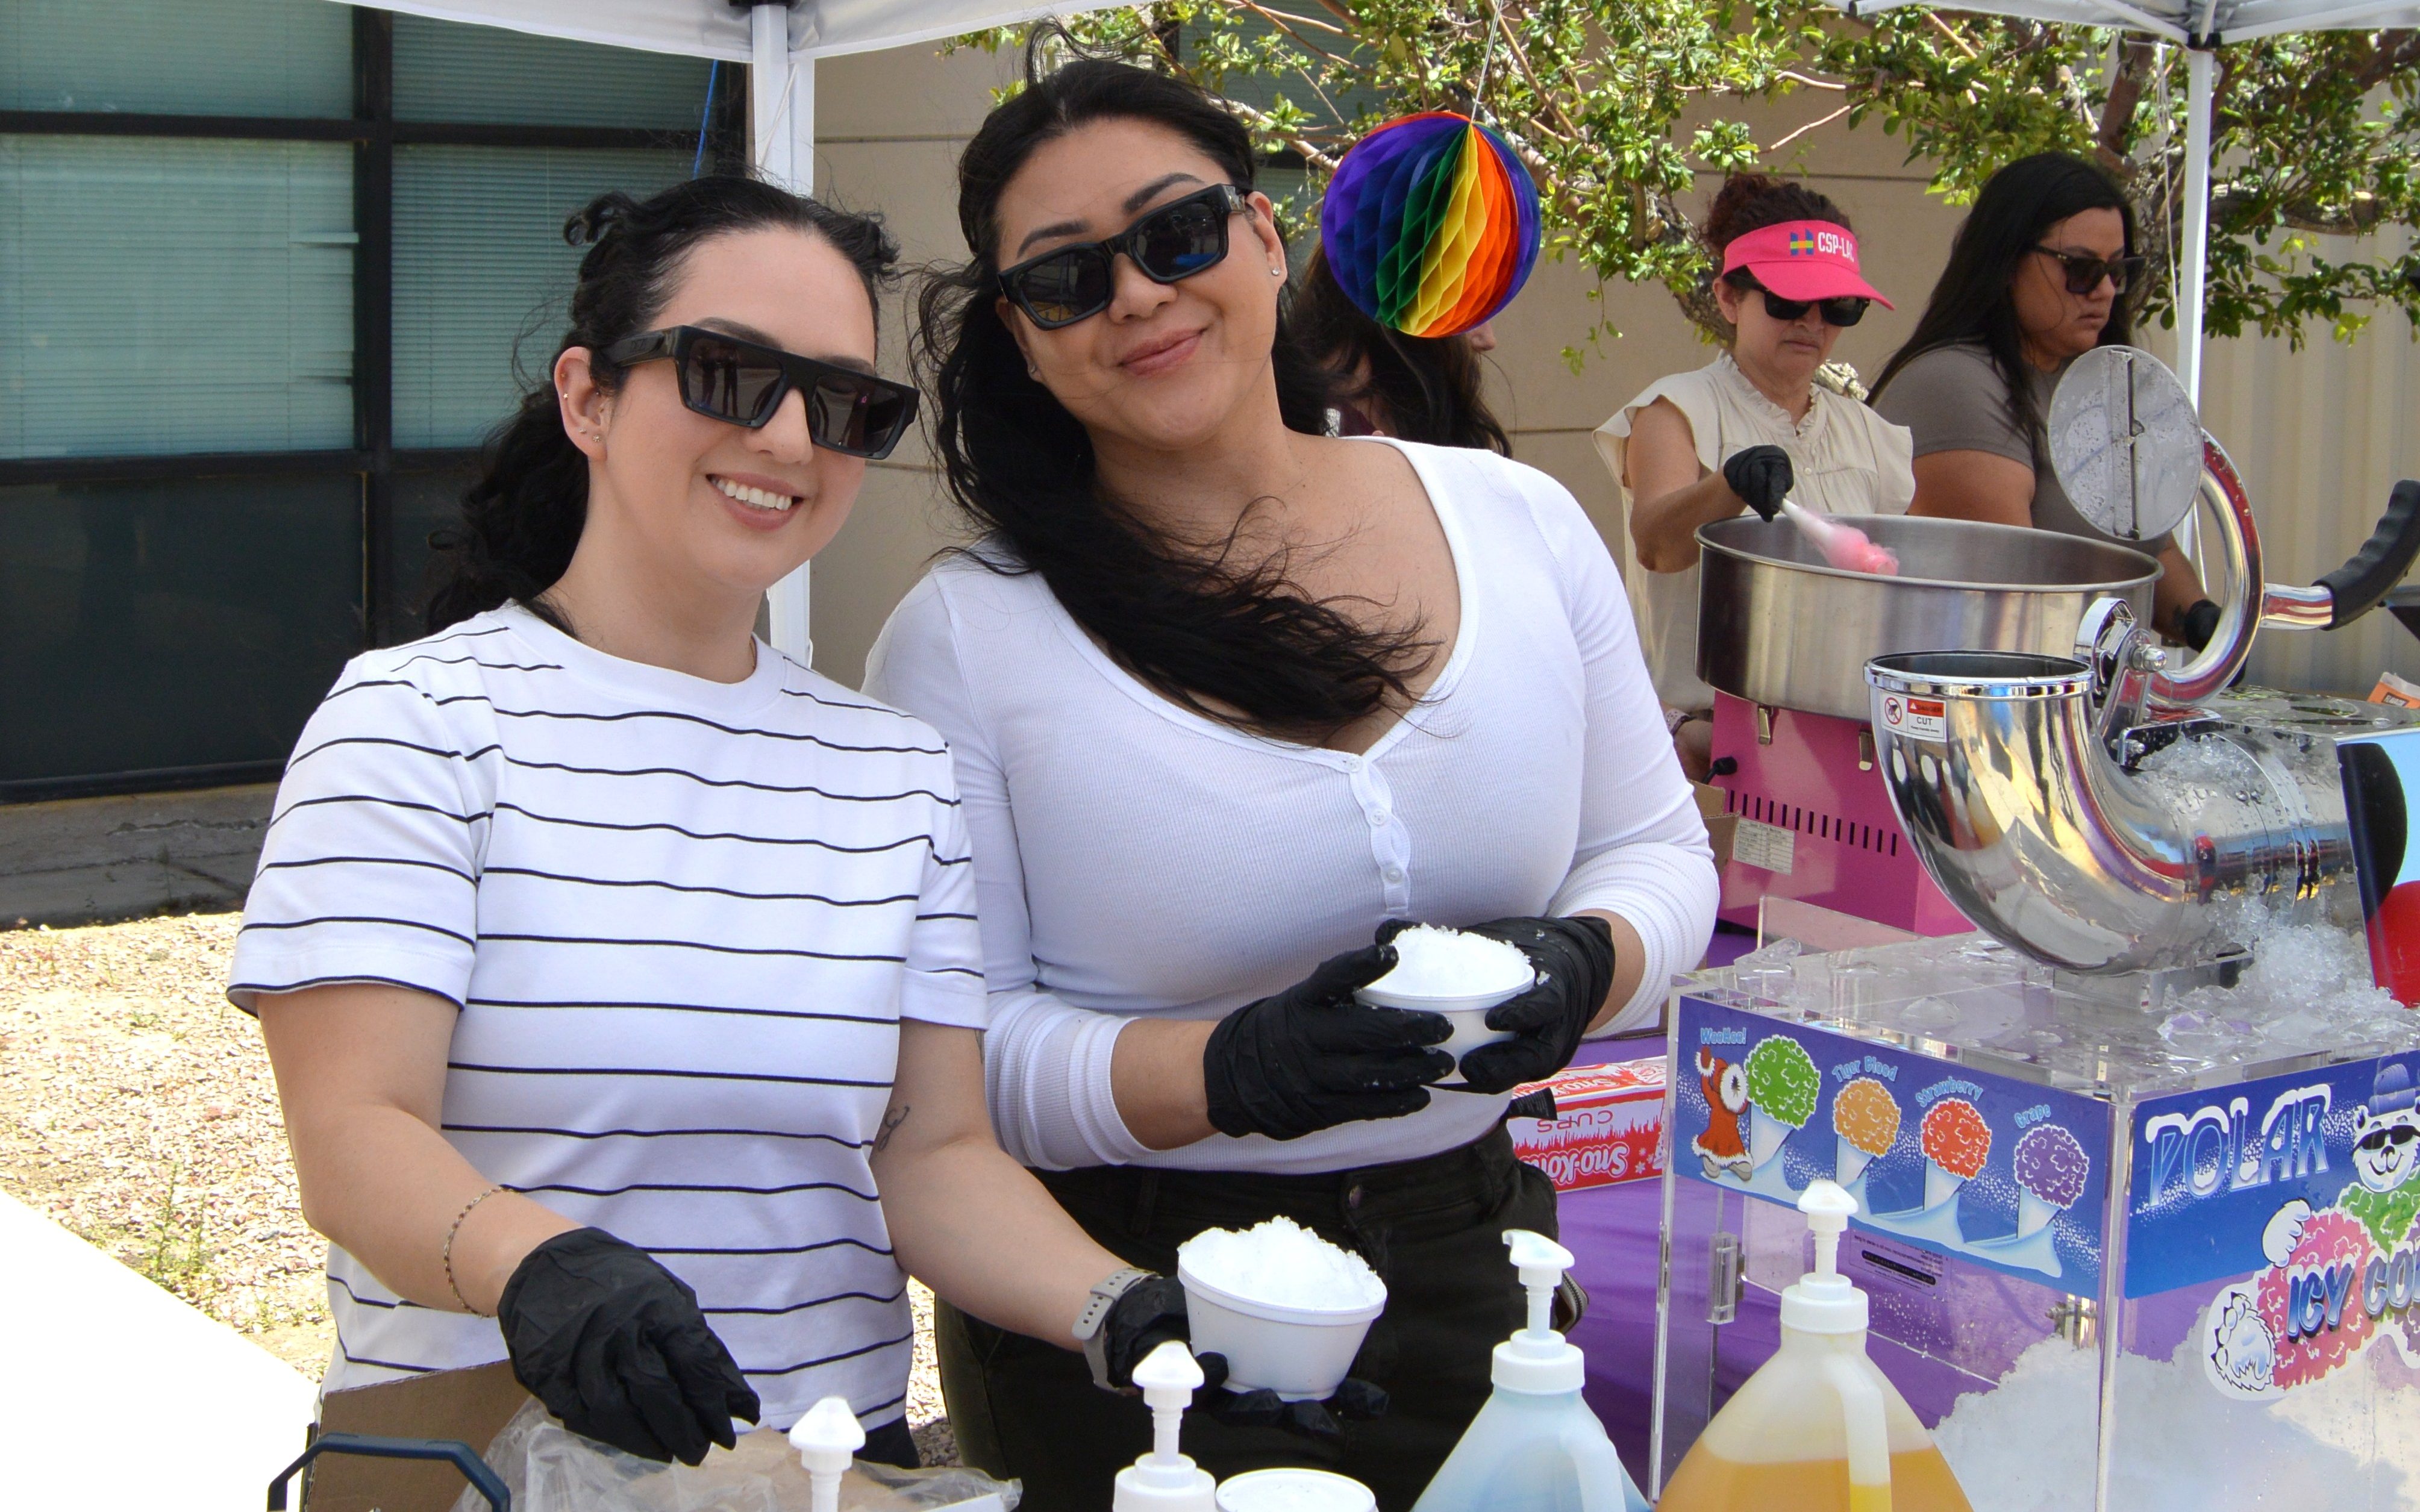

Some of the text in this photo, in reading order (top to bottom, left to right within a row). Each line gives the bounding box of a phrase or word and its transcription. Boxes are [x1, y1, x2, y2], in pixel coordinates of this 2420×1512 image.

[1916, 717, 1933, 725] CUT
[1832, 1055, 1898, 1082] Tiger Blood
[1915, 1076, 1983, 1107] Strawberry
[1536, 1110, 1613, 1132] CUPS
[2015, 1104, 2051, 1128] Grape
[2146, 1084, 2331, 1206] POLAR
[2287, 1252, 2356, 1341] ICY
